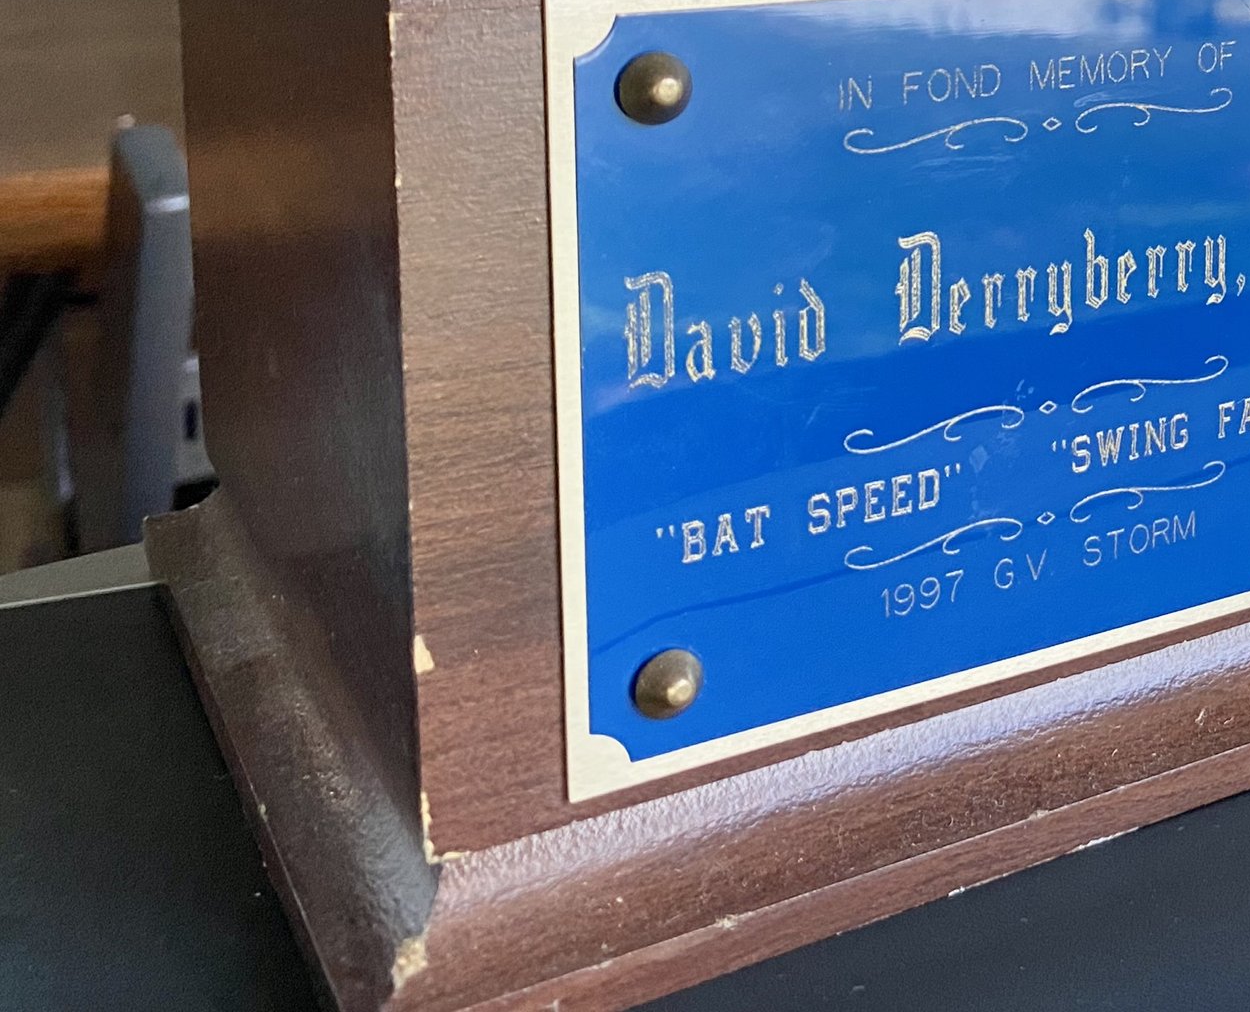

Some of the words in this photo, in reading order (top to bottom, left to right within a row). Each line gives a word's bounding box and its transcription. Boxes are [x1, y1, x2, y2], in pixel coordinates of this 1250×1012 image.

[838, 74, 874, 112] IN
[902, 63, 1001, 106] FOND
[1028, 45, 1174, 91] MEMORY
[1197, 40, 1238, 73] OF
[624, 270, 826, 392] David
[895, 227, 1247, 346] Derryberry,
[655, 504, 772, 565] "BAT
[807, 462, 962, 535] SPEED"
[1051, 412, 1189, 474] "SWING
[880, 568, 965, 619] 1997
[1082, 509, 1197, 567] STORM
